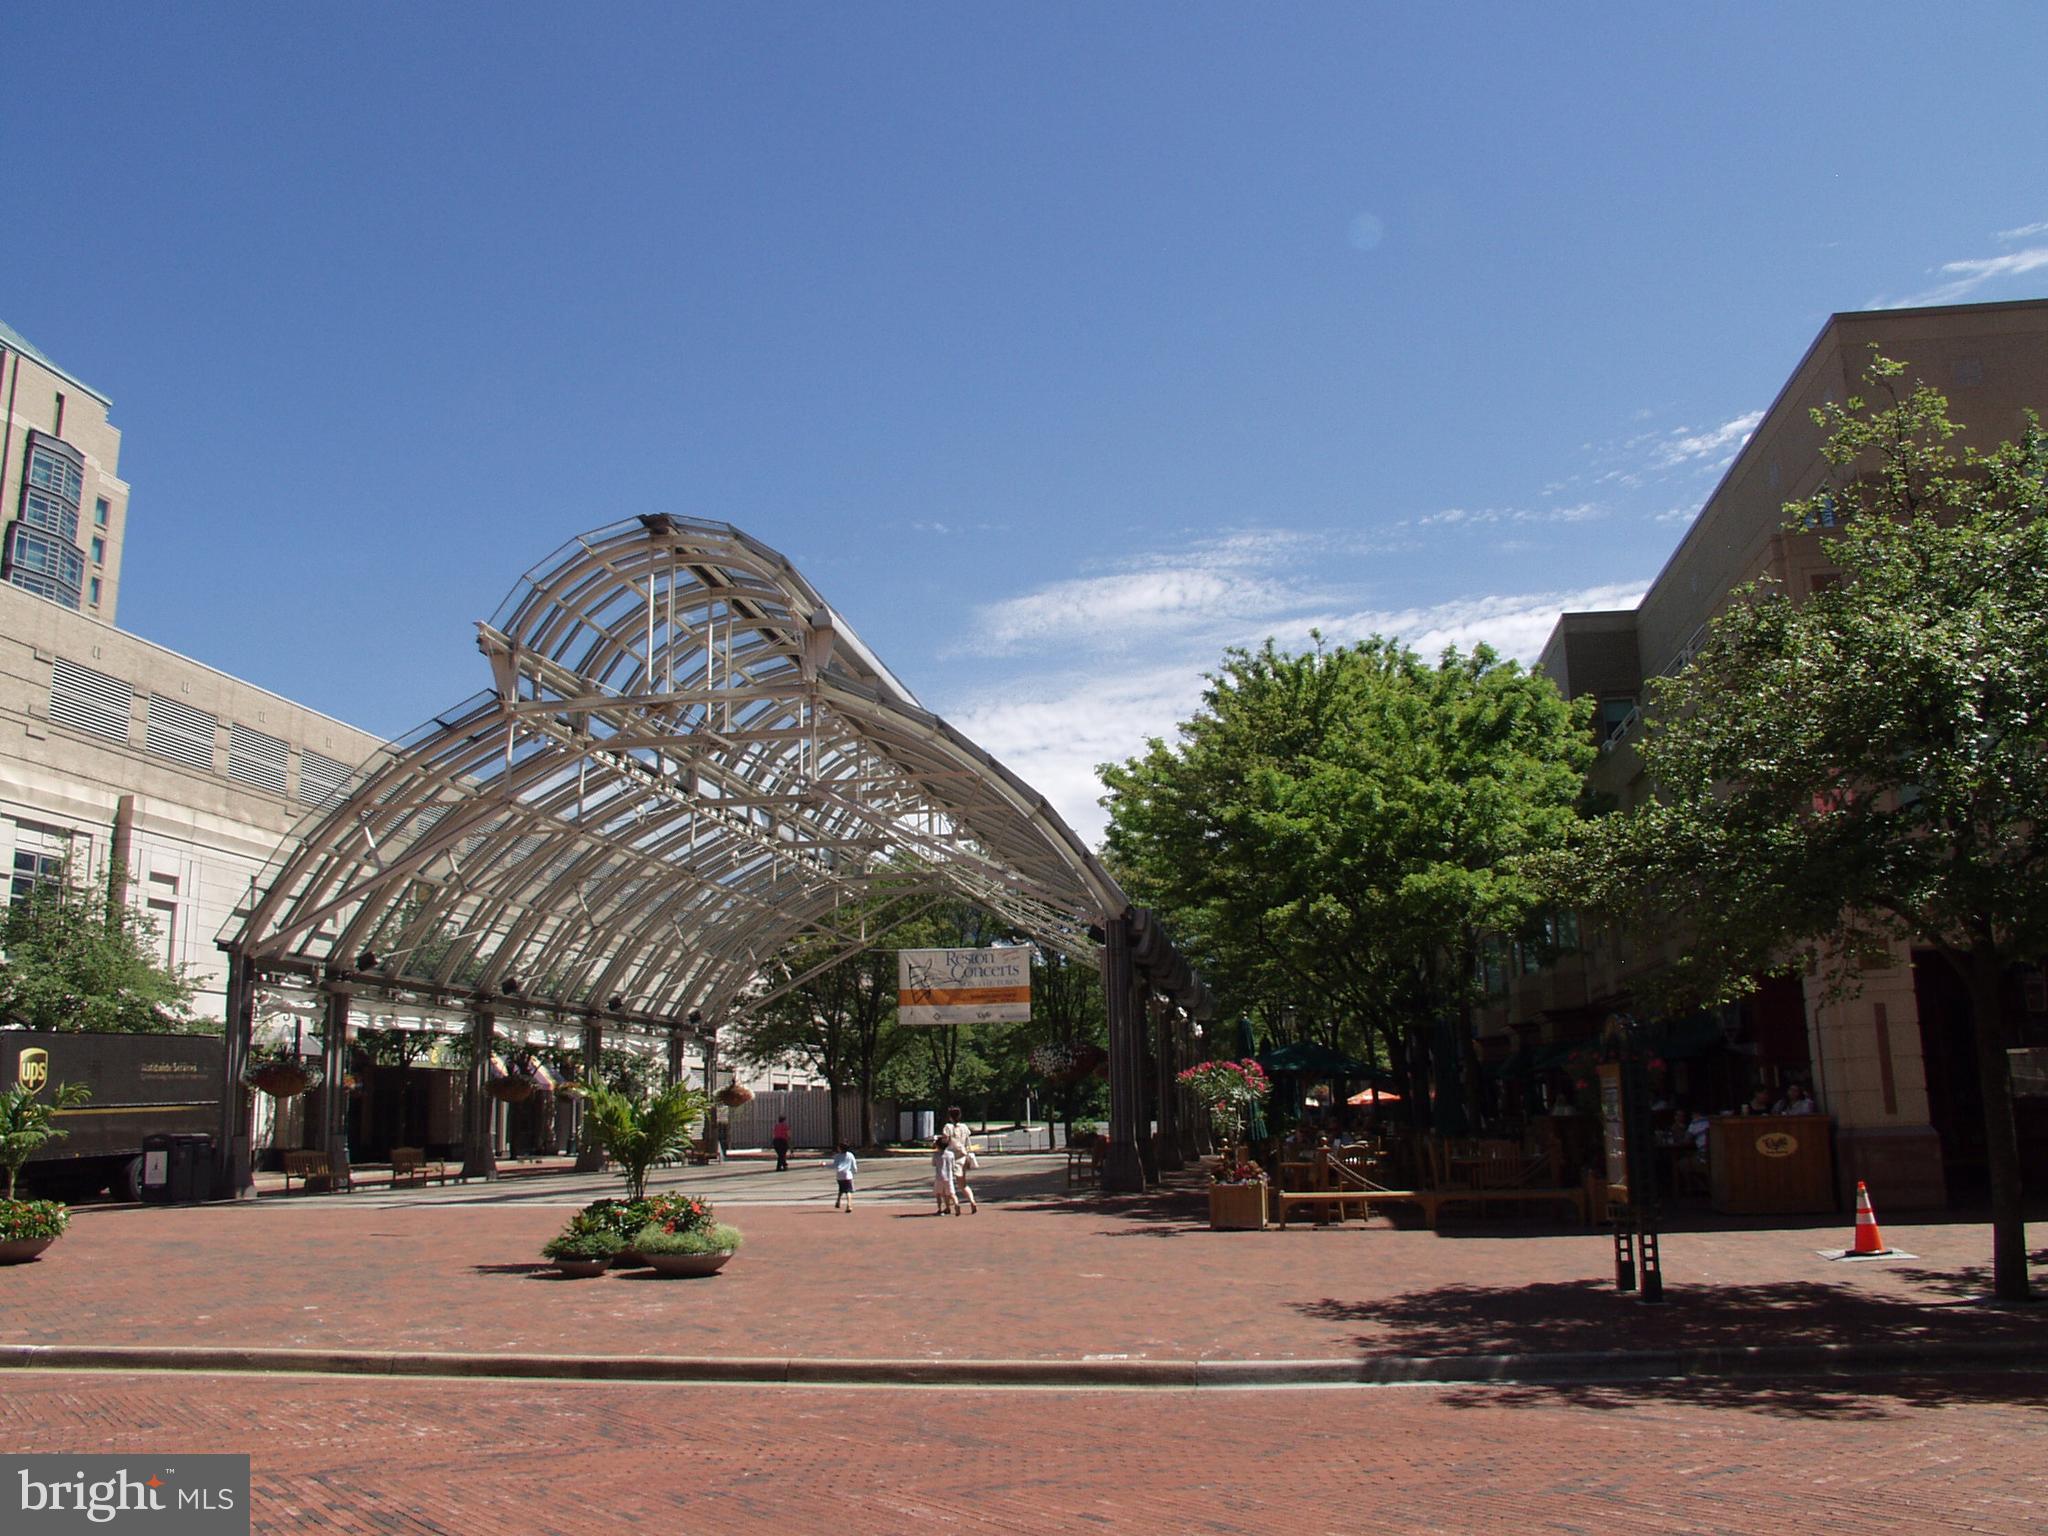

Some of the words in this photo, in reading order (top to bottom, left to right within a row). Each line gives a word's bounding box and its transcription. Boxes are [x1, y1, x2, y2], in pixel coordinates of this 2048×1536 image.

[946, 950, 994, 966] Reston
[951, 964, 1020, 979] Concerts
[22, 1061, 46, 1087] ups
